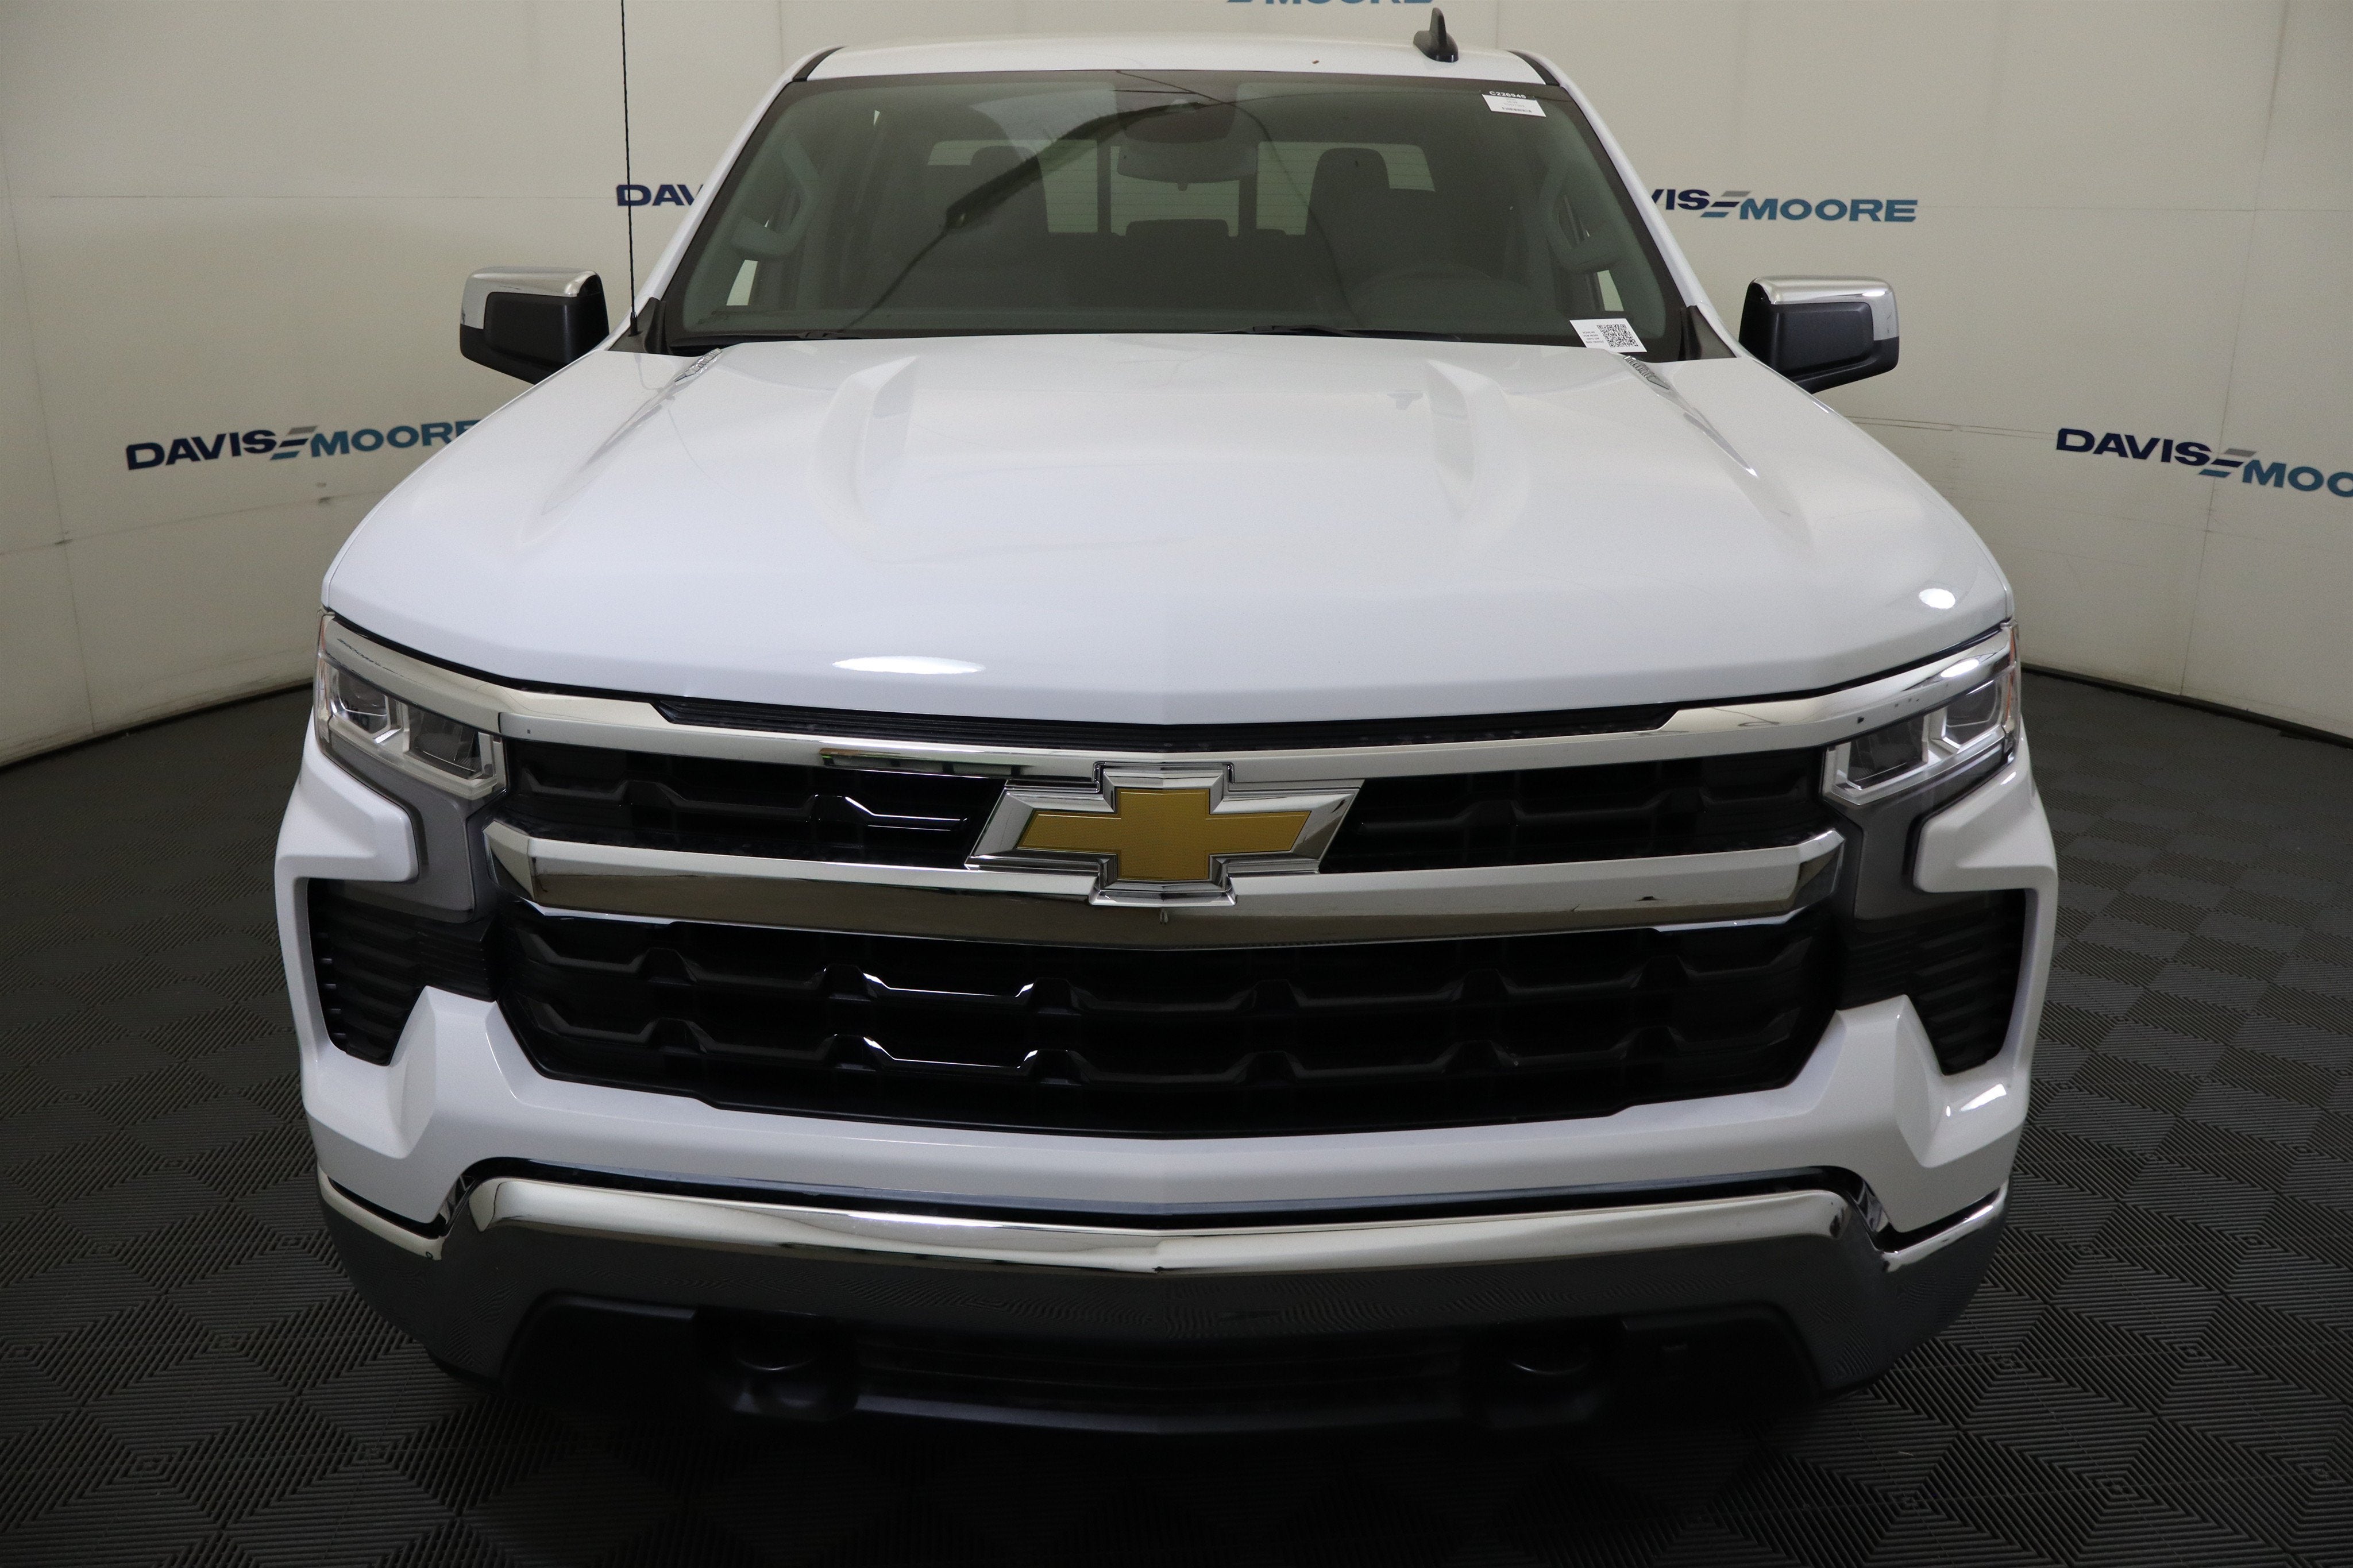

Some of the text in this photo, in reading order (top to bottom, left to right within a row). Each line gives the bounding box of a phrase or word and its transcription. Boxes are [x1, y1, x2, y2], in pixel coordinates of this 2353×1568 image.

[1740, 199, 1919, 222] MOORE
[126, 430, 276, 470] DAVIS
[2056, 428, 2211, 466] DAVIS
